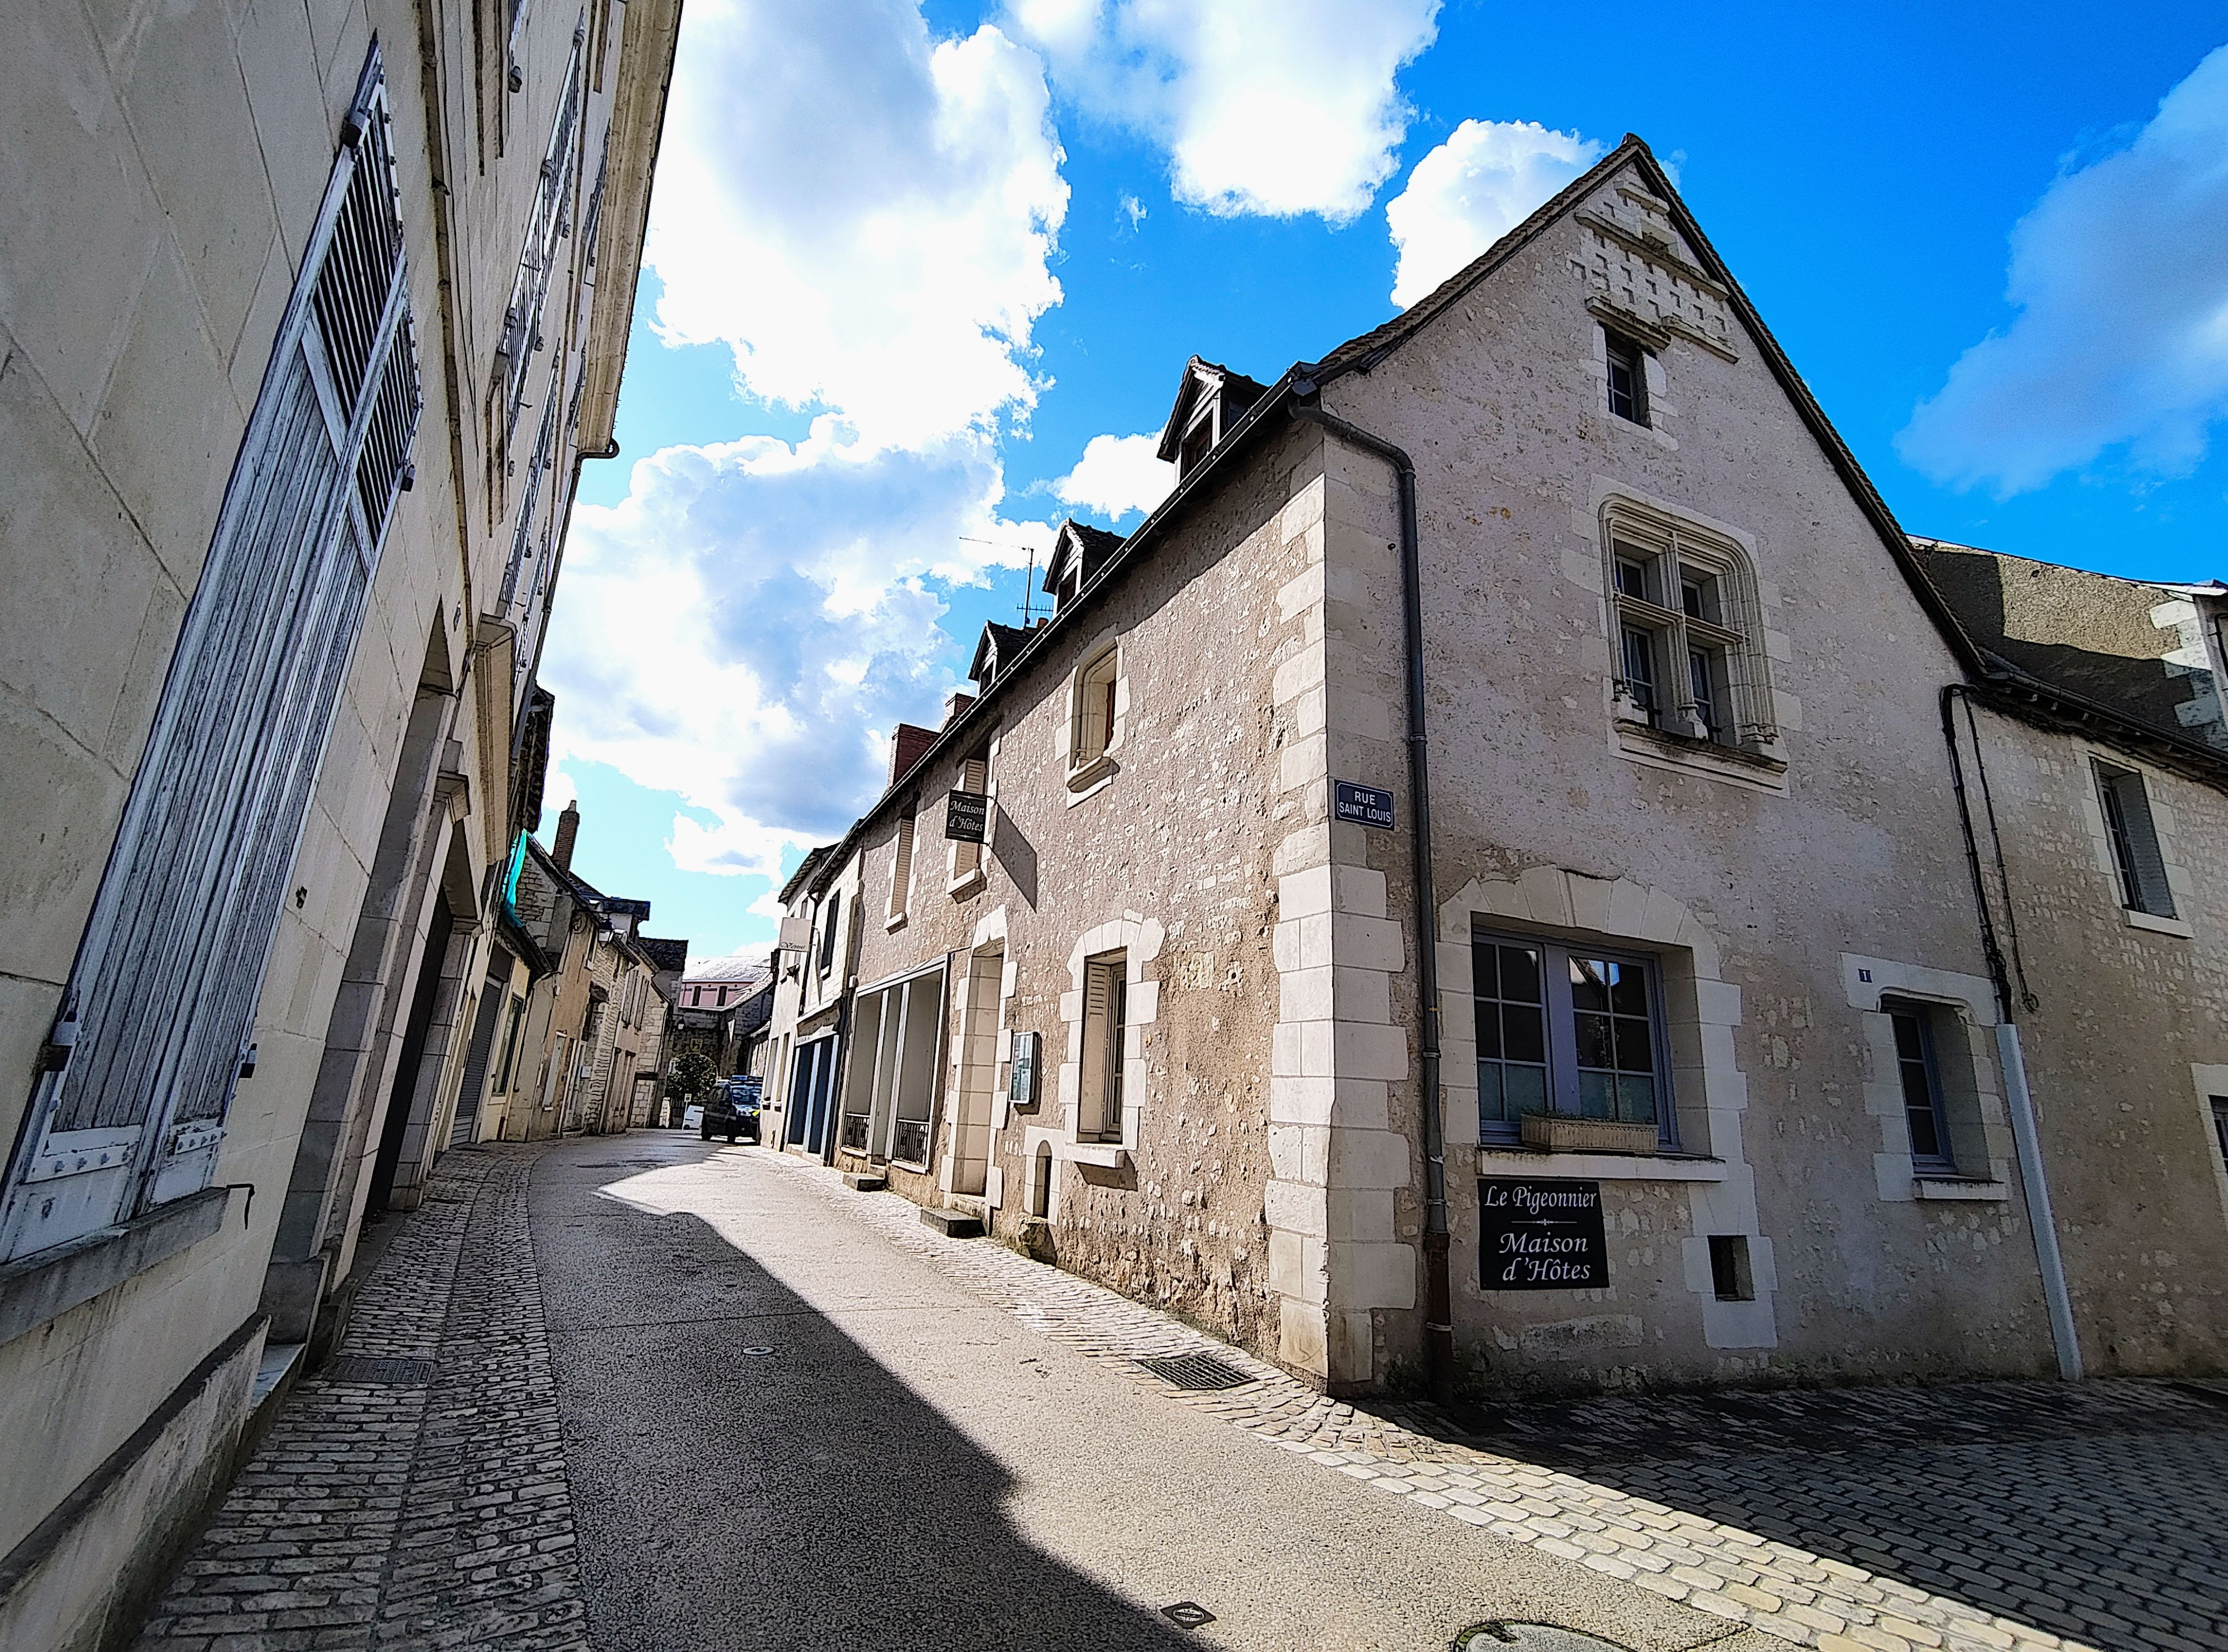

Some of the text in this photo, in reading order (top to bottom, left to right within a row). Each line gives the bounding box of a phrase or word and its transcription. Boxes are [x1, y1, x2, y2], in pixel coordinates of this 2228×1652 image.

[1355, 791, 1376, 805] RUE
[950, 801, 984, 815] Maison
[1339, 802, 1391, 822] SAINT LOUIS
[949, 815, 983, 832] d'Hôtes
[1863, 971, 1867, 981] 1
[1485, 1186, 1597, 1215] Le Pigeonnier
[1499, 1232, 1588, 1253] Maison
[1502, 1257, 1591, 1281] d'Hôtes
